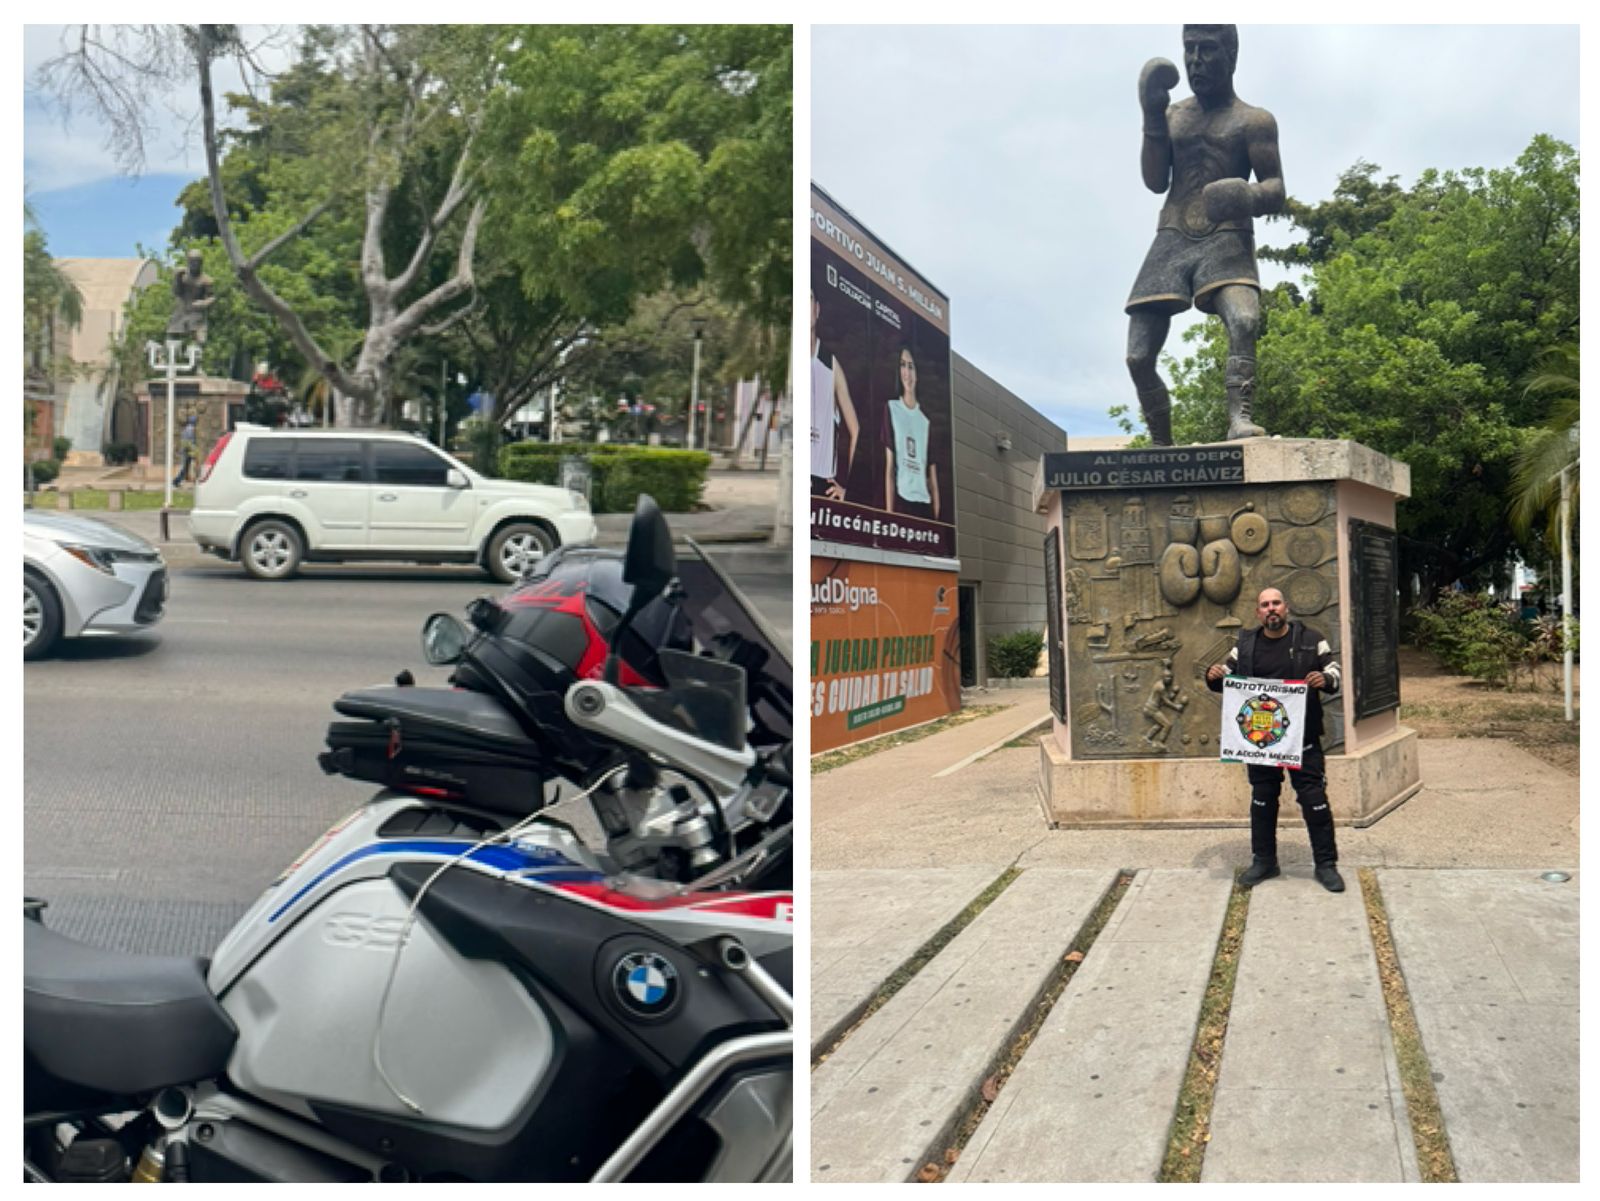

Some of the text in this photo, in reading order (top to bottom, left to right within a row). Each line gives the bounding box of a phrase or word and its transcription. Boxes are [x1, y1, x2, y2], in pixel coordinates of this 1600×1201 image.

[866, 251, 895, 284] JUAN
[896, 276, 907, 293] S.
[1094, 450, 1243, 466] AL MÉRITO DEPO
[1050, 464, 1243, 486] JULIO CÉSAR CHÁVEZ
[828, 674, 880, 715] CUIDAR
